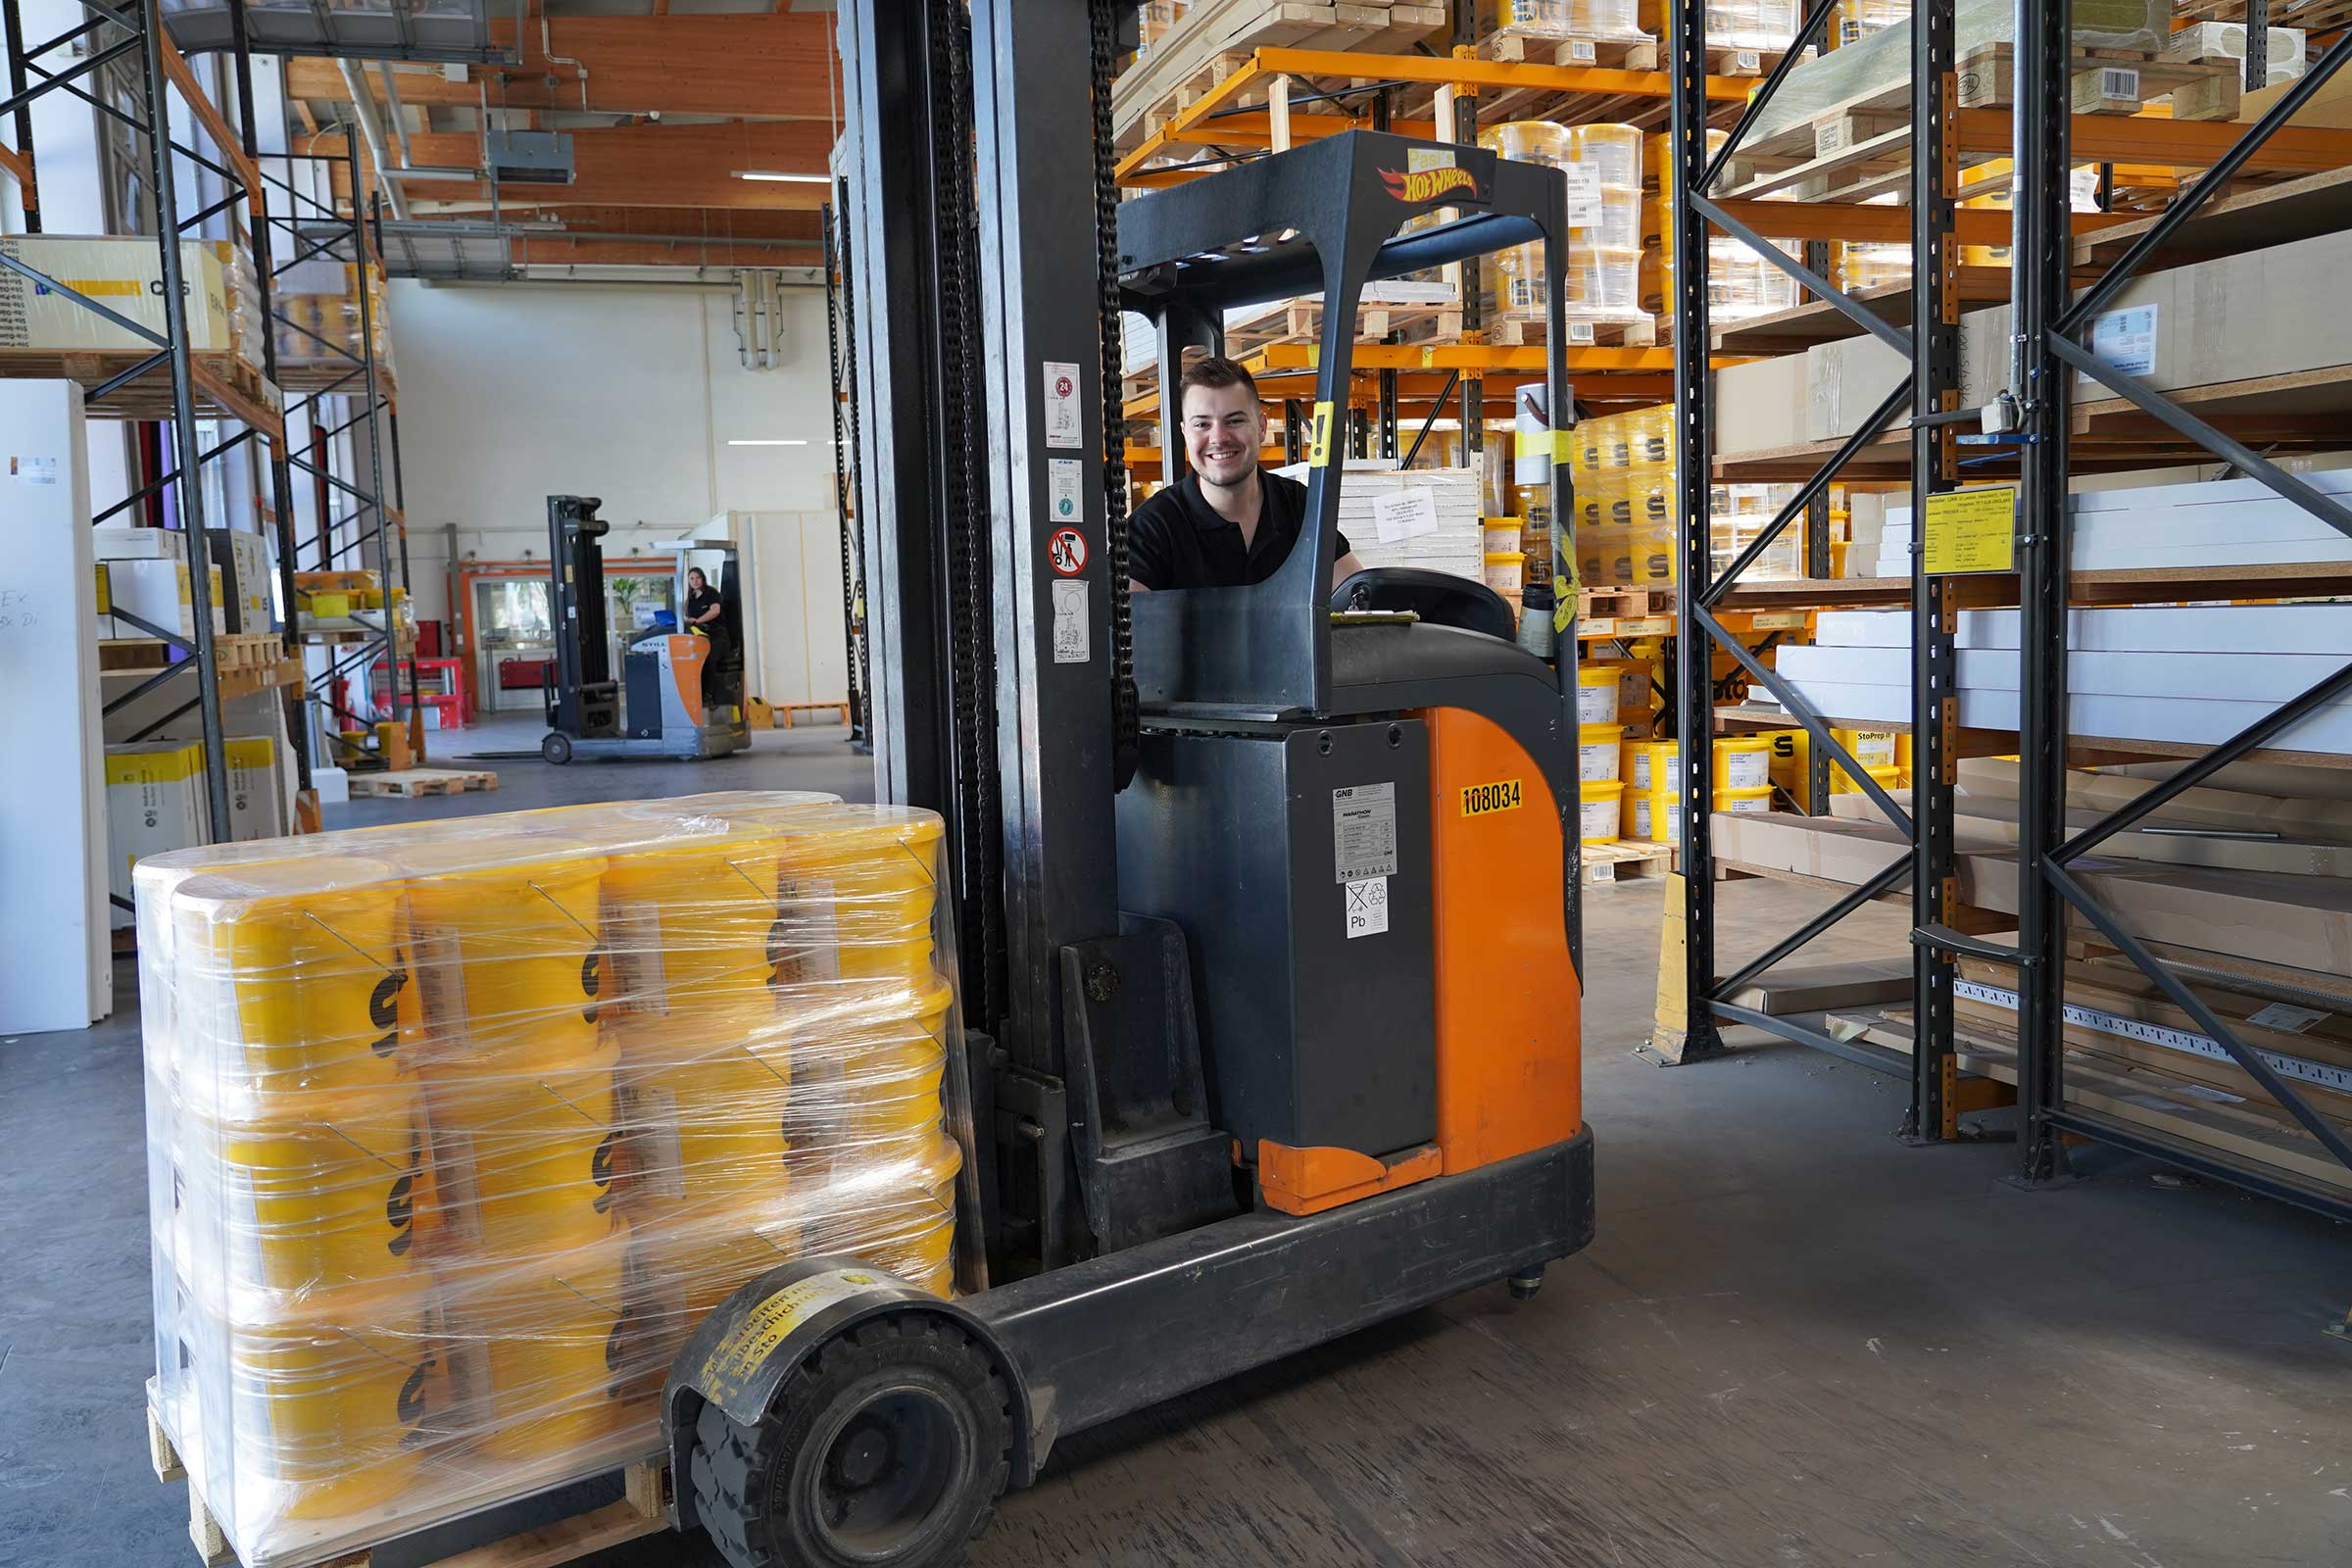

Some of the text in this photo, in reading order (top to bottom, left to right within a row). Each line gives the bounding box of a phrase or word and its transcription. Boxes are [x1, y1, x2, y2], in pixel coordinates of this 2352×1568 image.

[1059, 381, 1069, 392] 24
[1335, 789, 1353, 798] GNB
[1463, 781, 1520, 814] 108034
[1351, 916, 1366, 928] Pb
[753, 1333, 778, 1358] Sto
